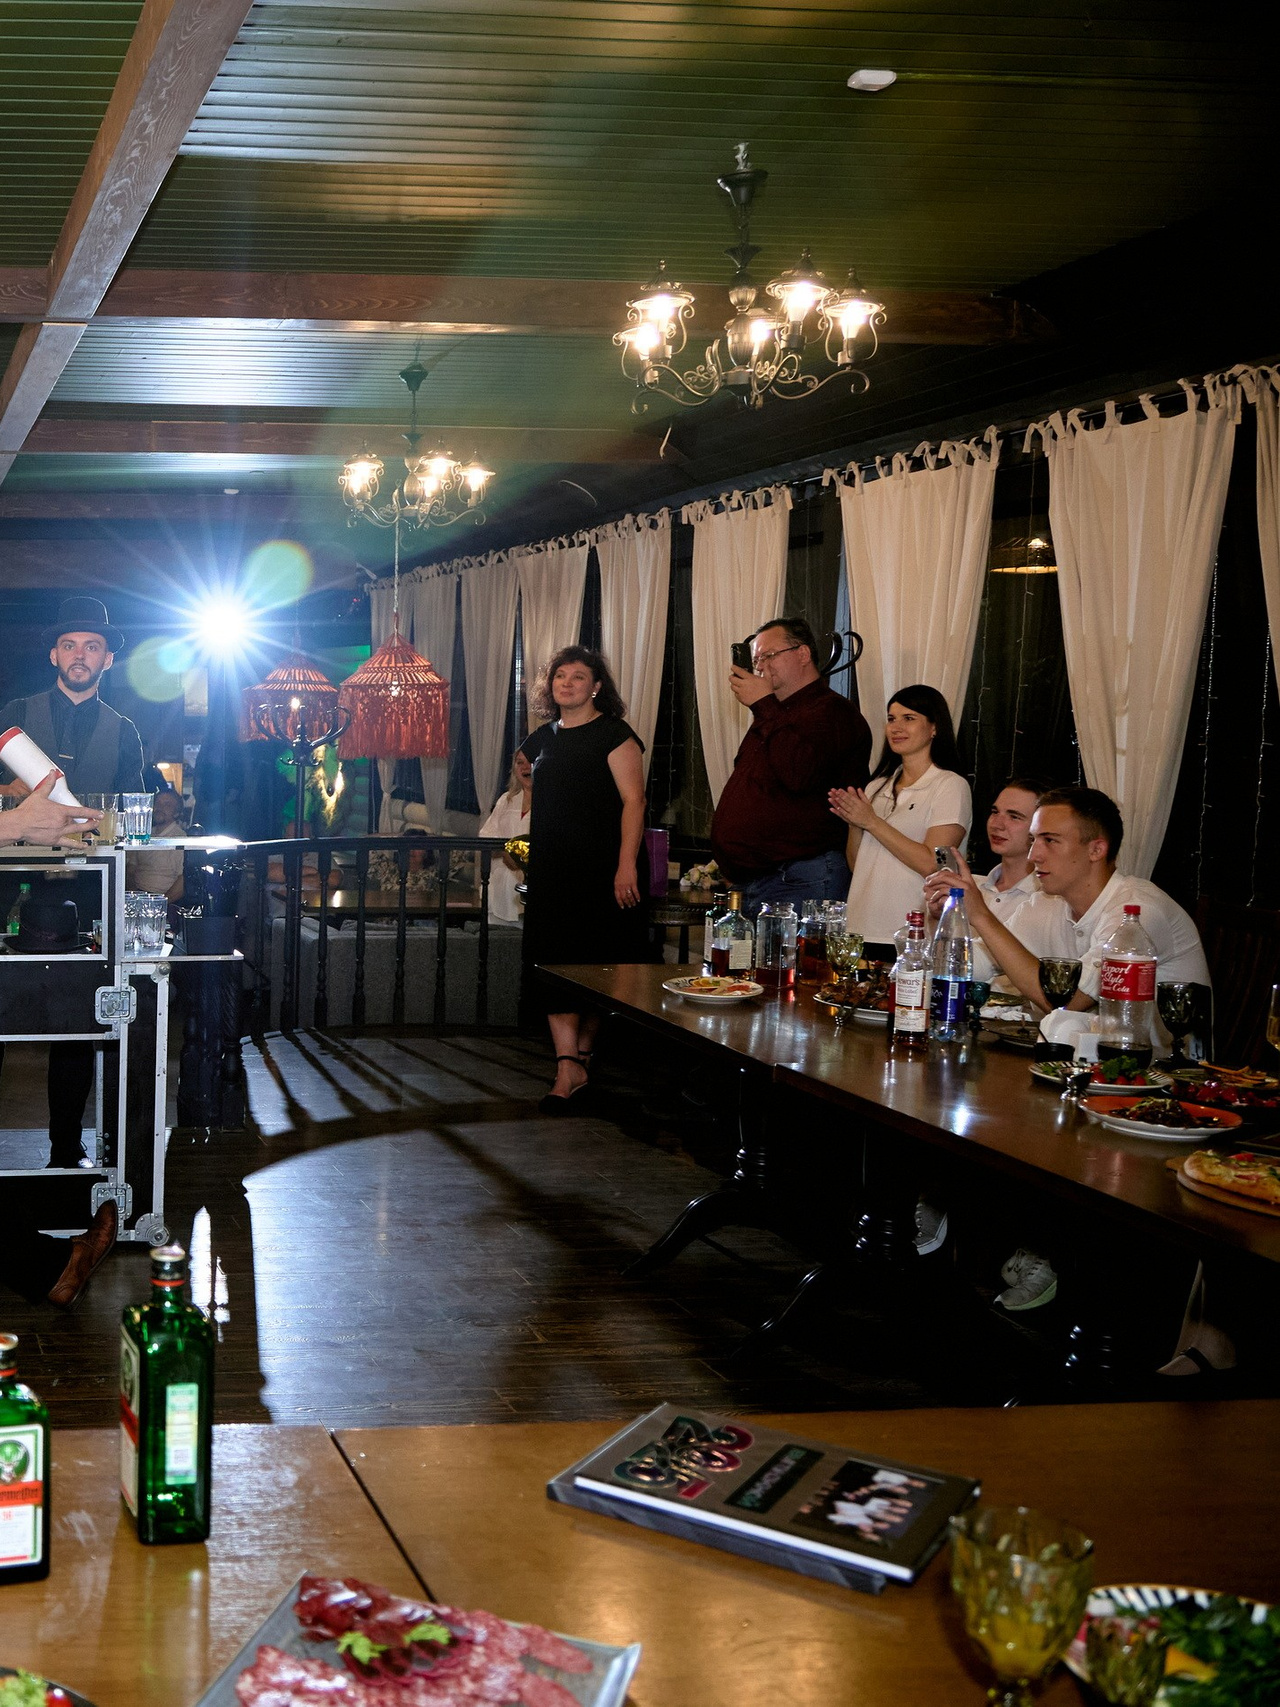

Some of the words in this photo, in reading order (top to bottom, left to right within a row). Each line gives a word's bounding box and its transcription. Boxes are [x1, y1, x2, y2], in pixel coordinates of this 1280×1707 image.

[1102, 961, 1132, 976] Export
[1102, 971, 1124, 985] Style
[1112, 983, 1130, 992] Cola
